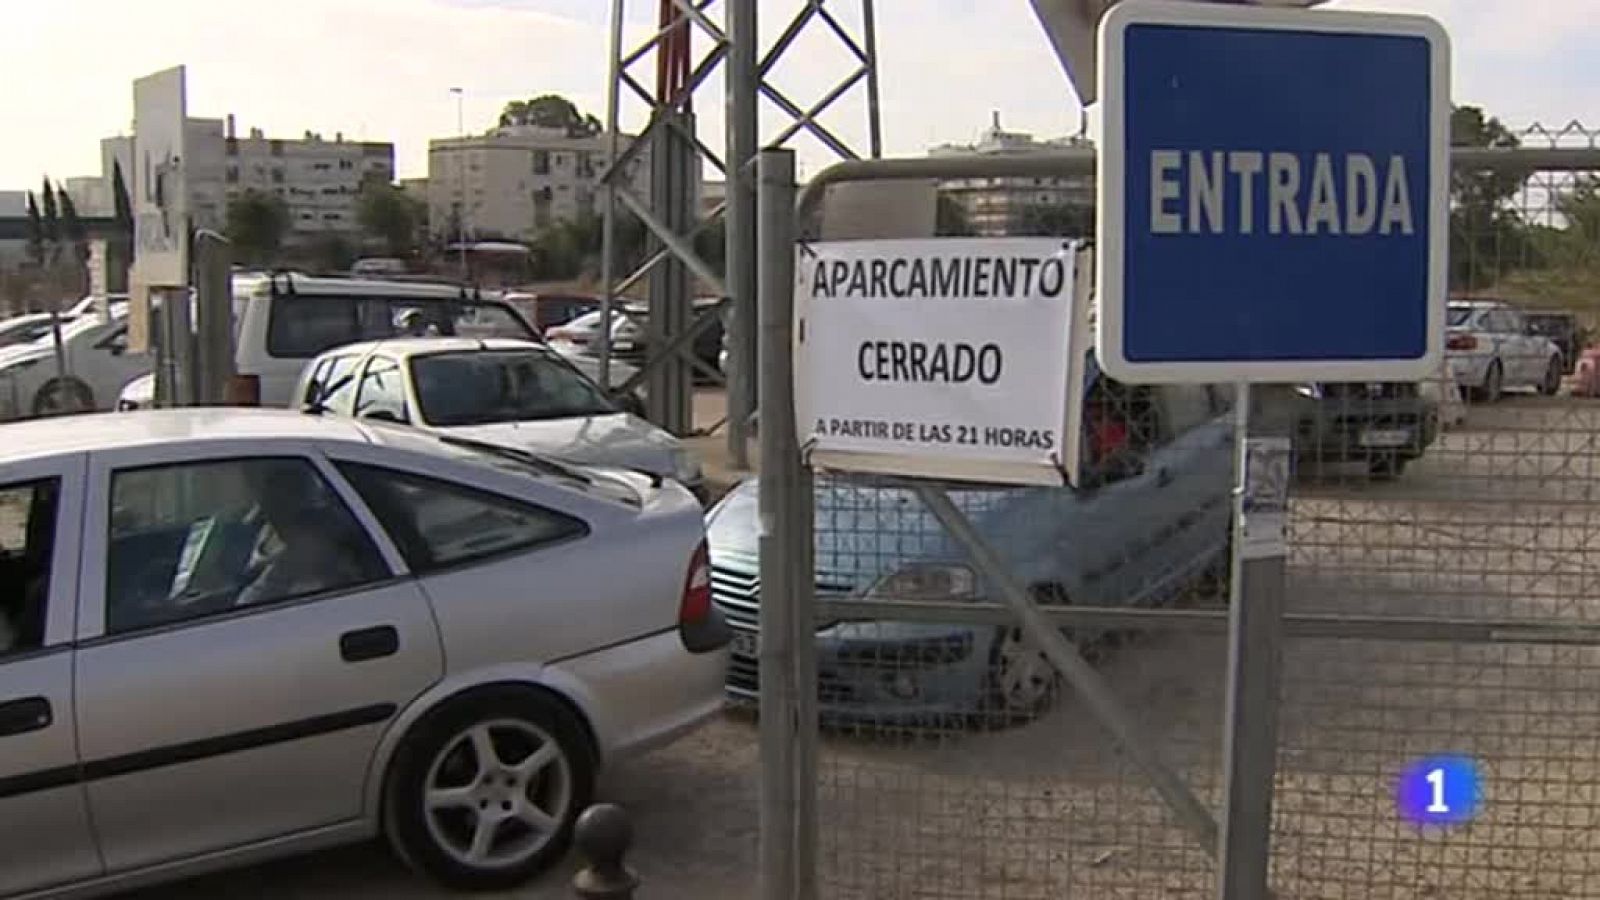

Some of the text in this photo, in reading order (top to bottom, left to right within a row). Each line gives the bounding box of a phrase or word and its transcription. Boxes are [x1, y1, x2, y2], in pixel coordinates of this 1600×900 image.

[1149, 149, 1414, 235] ENTRADA
[812, 257, 1065, 298] APARCAMIENTO
[858, 341, 1003, 384] CERRADO
[815, 418, 1054, 449] A PARTIR DE LAS 21 HORAS
